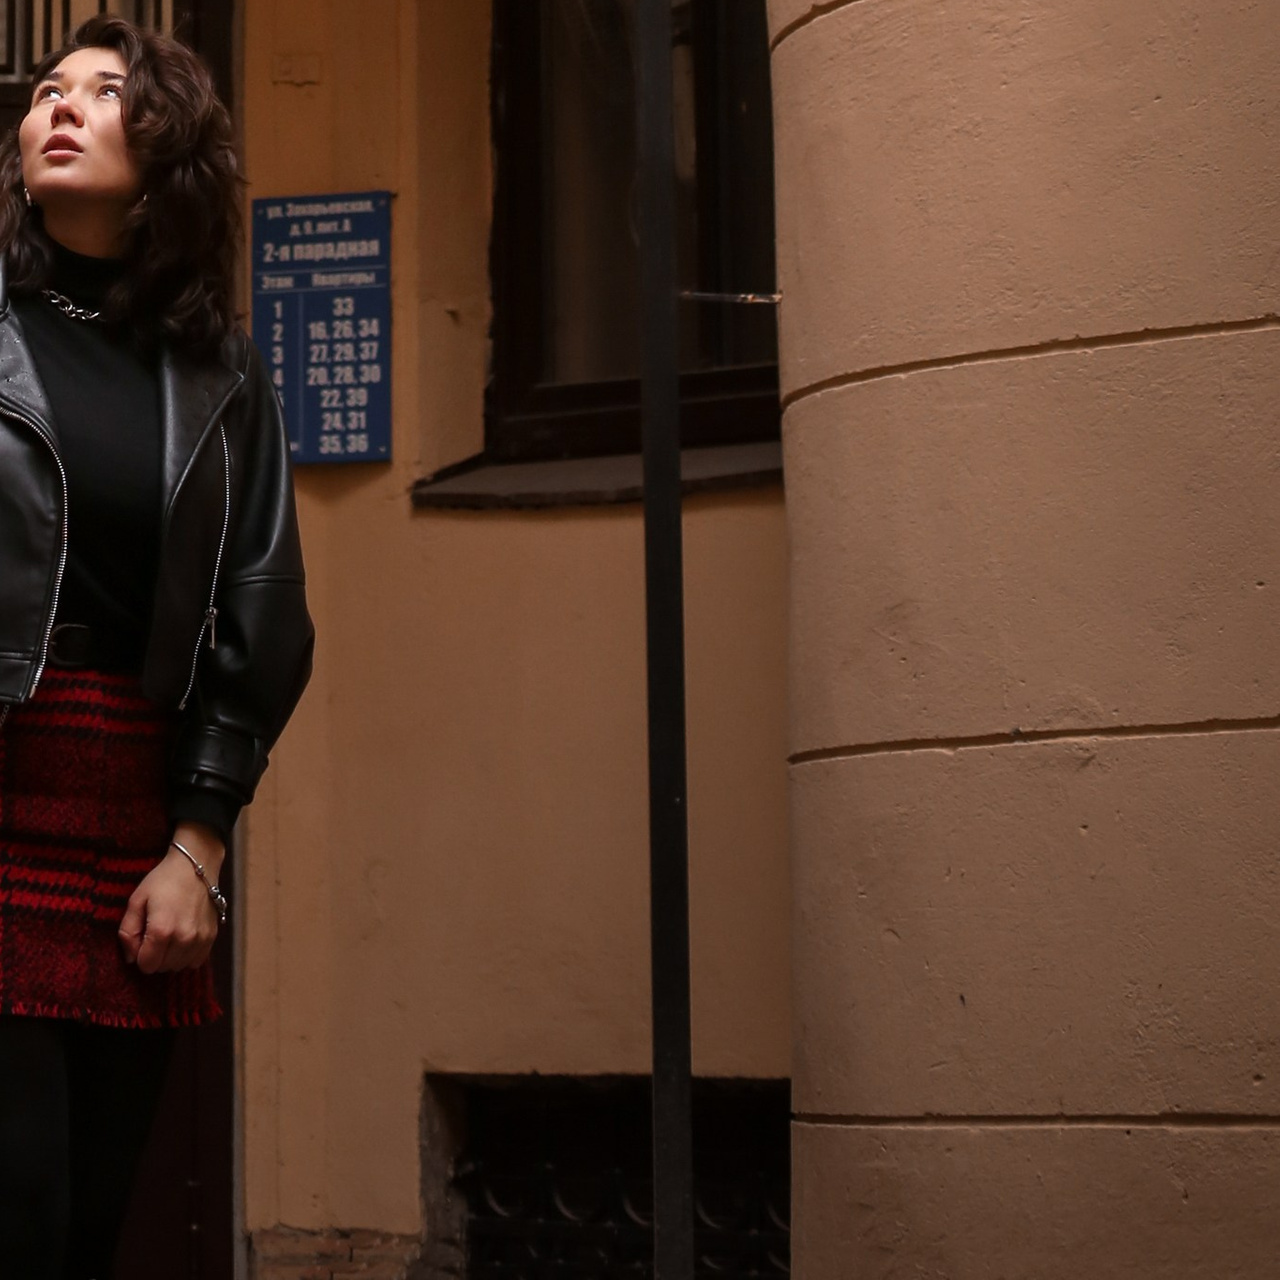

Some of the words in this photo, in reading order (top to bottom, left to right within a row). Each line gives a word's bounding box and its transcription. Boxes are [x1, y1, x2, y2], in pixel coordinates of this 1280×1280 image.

[342, 218, 352, 233] А
[263, 243, 290, 262] 2-я
[293, 239, 380, 262] парадная
[312, 273, 376, 287] Квартиры
[274, 301, 282, 319] 1
[333, 297, 354, 316] 33
[272, 323, 283, 342] 2
[358, 318, 379, 337] 34
[272, 346, 283, 364] 3
[359, 341, 379, 360] 37
[273, 368, 283, 386] 4
[359, 364, 381, 383] 30
[348, 411, 366, 429] 31
